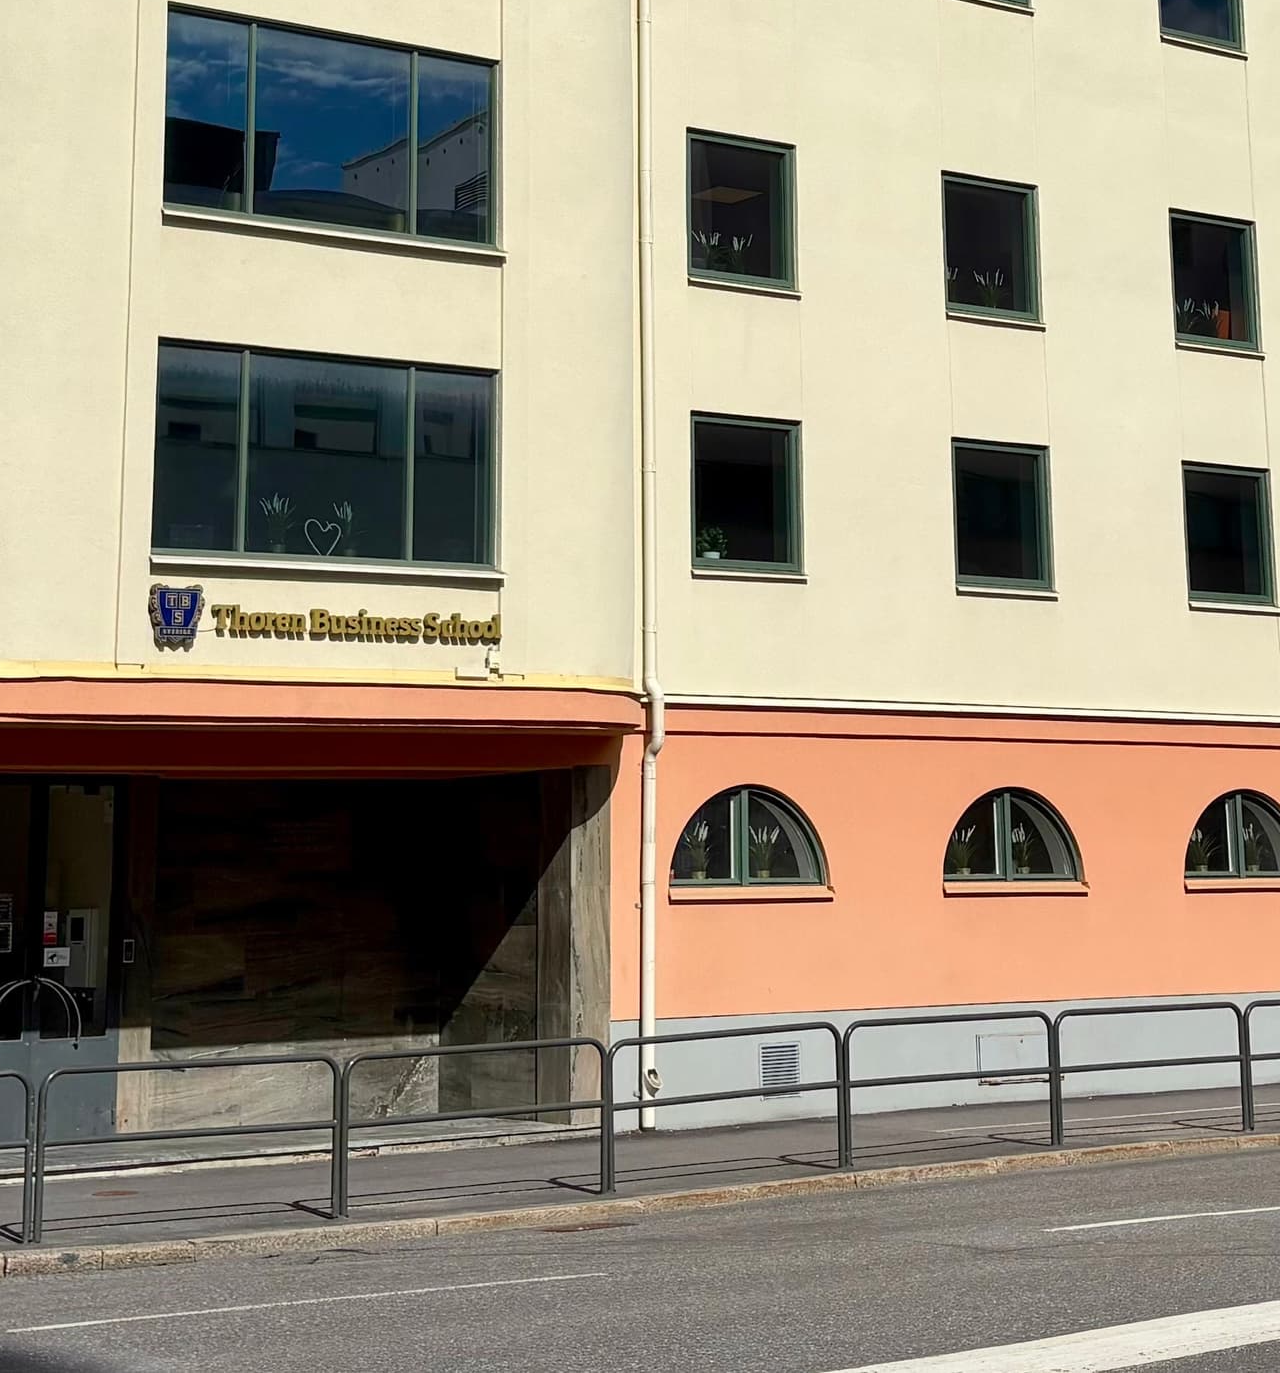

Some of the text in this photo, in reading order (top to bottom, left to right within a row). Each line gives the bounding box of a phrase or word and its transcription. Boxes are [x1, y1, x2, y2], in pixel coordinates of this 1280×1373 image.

[211, 604, 501, 639] Thoren Business School
